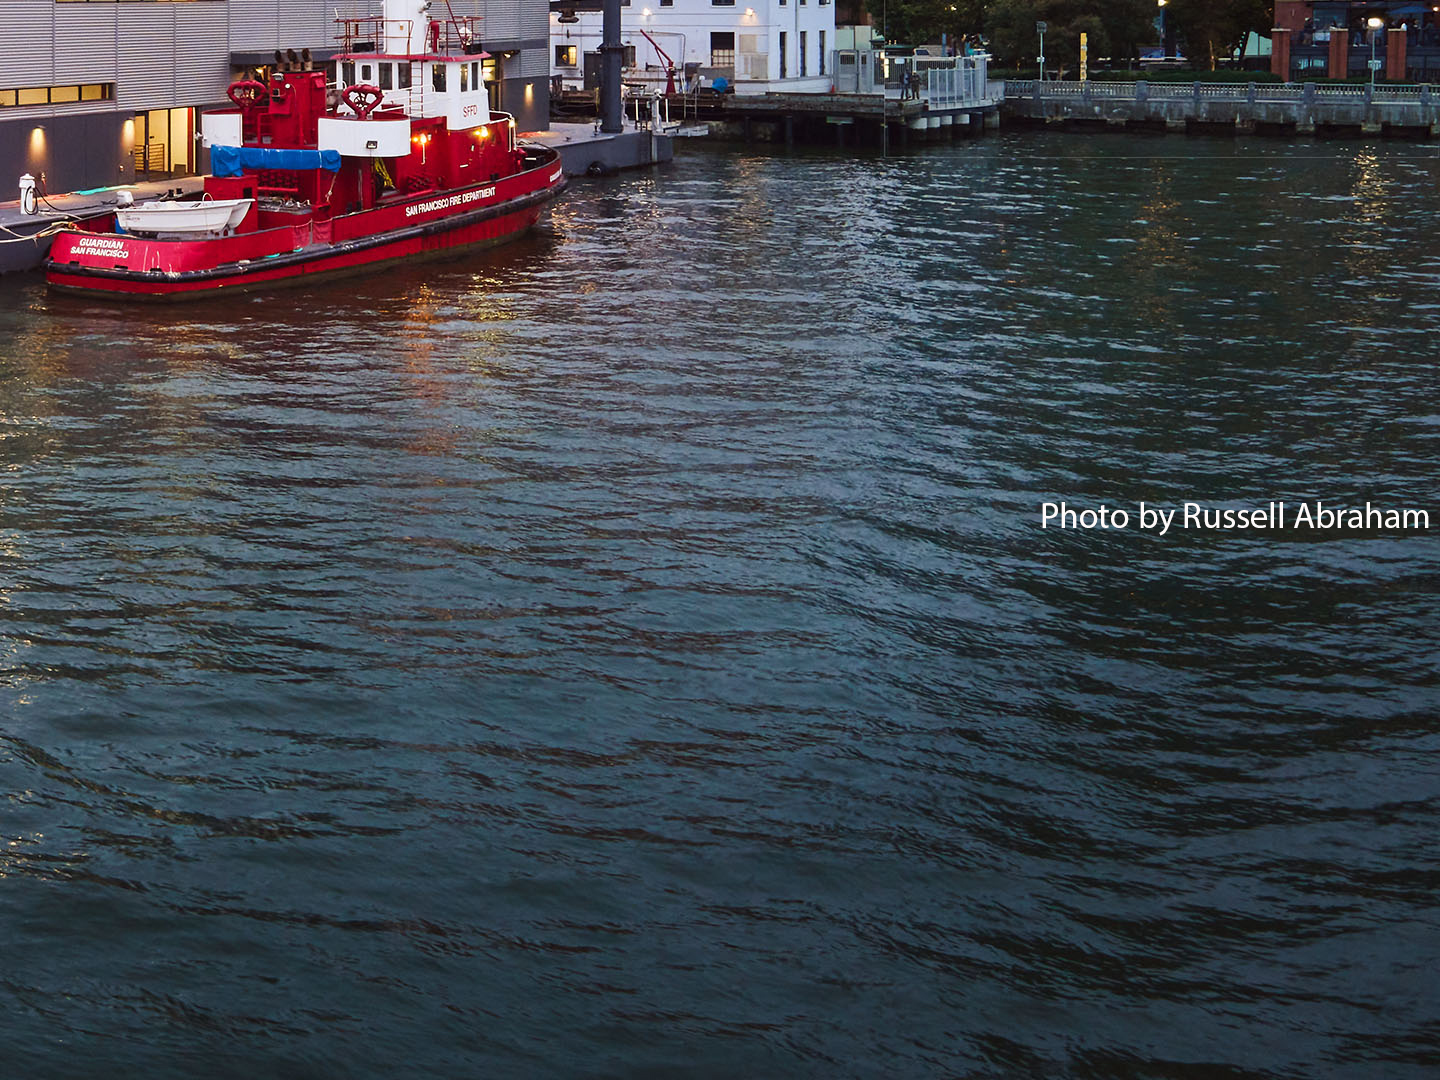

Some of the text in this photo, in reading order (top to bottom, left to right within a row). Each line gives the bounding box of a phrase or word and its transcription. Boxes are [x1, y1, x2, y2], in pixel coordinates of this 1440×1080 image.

[463, 104, 477, 117] SFFD
[405, 187, 495, 217] SAN FRANCISCO FIRE DEPARTMENT
[79, 238, 124, 249] GUARDIAN
[70, 246, 129, 258] SAN FRANCISCO
